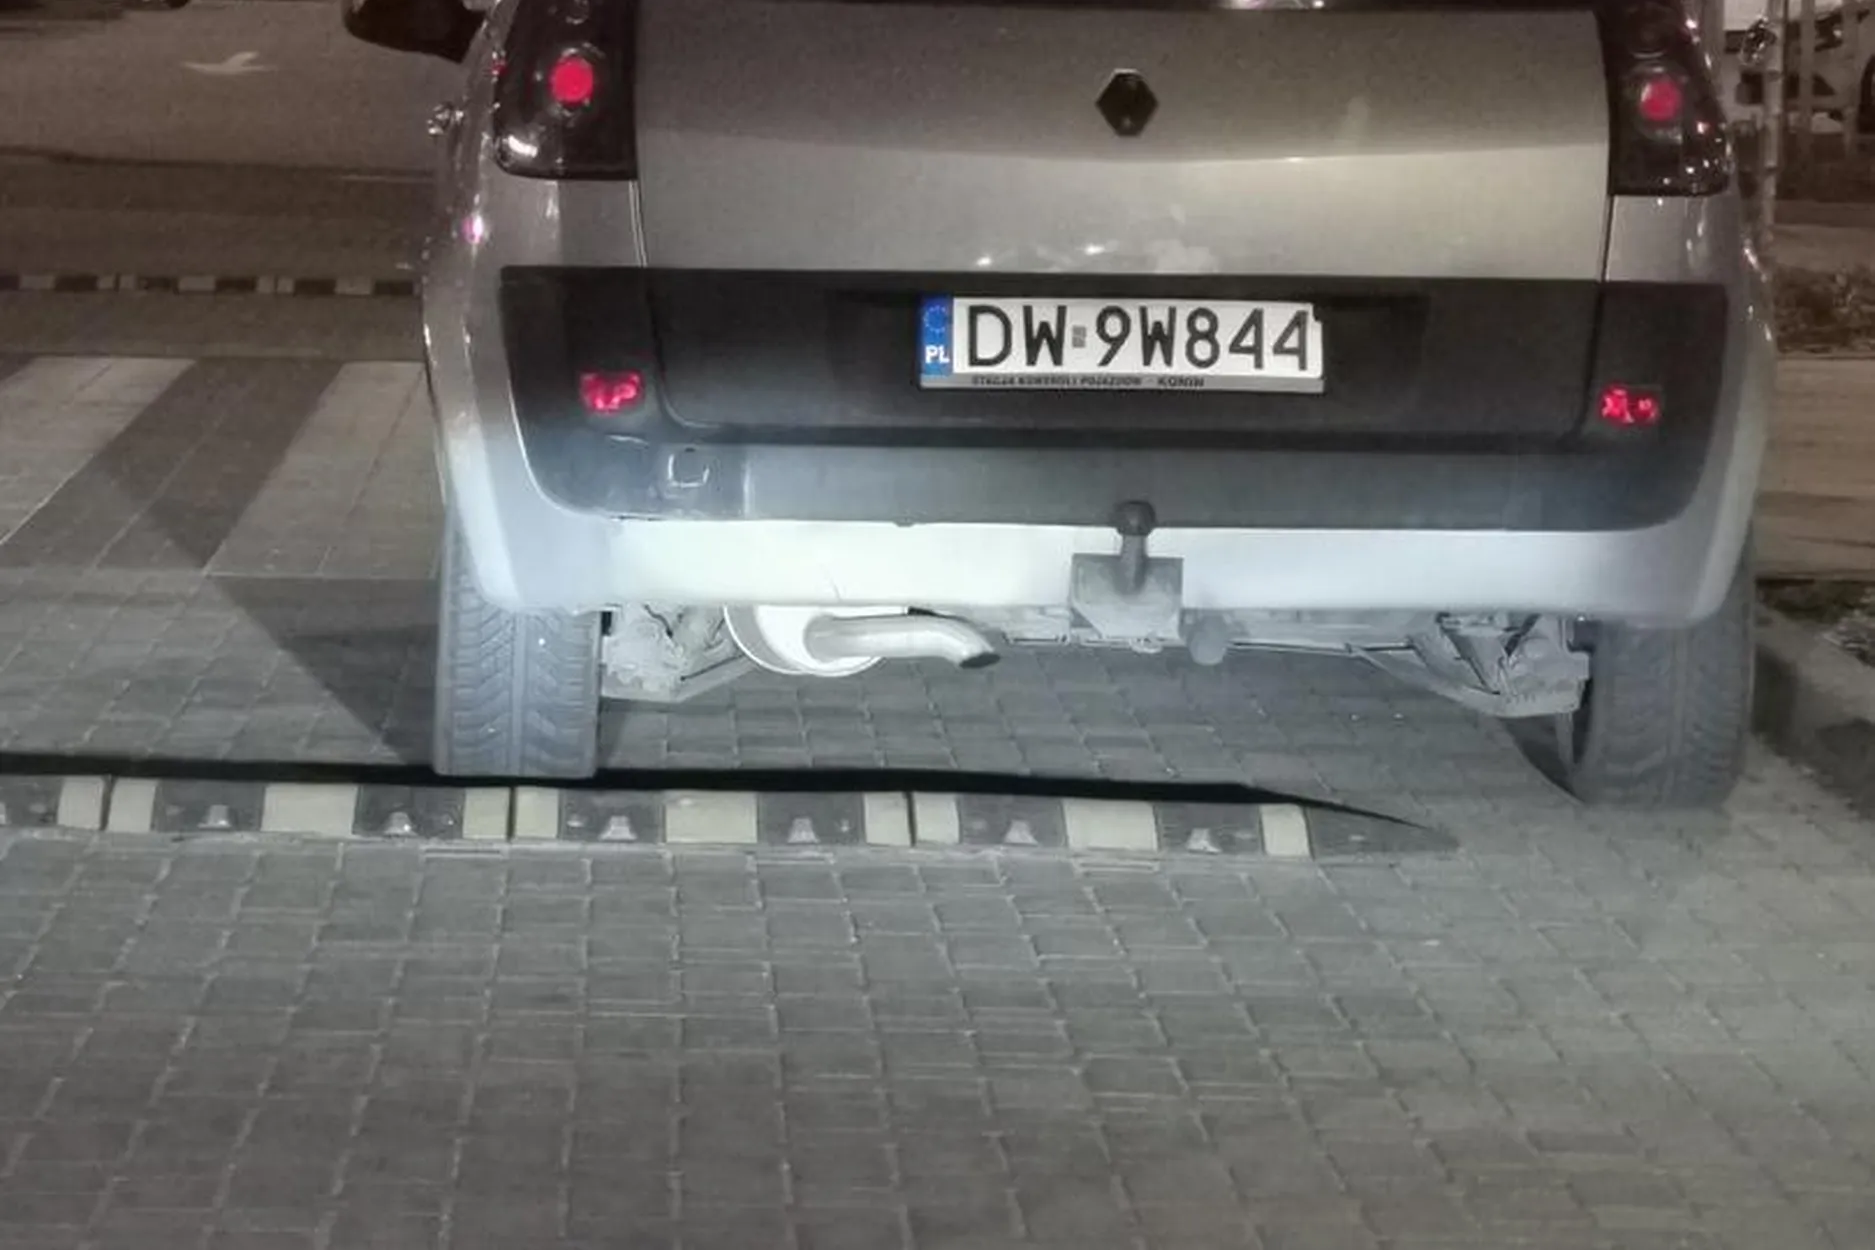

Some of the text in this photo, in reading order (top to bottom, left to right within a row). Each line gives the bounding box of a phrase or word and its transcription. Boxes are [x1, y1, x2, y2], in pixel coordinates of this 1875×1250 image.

[925, 344, 950, 364] PL
[967, 304, 1309, 370] DW 9W844
